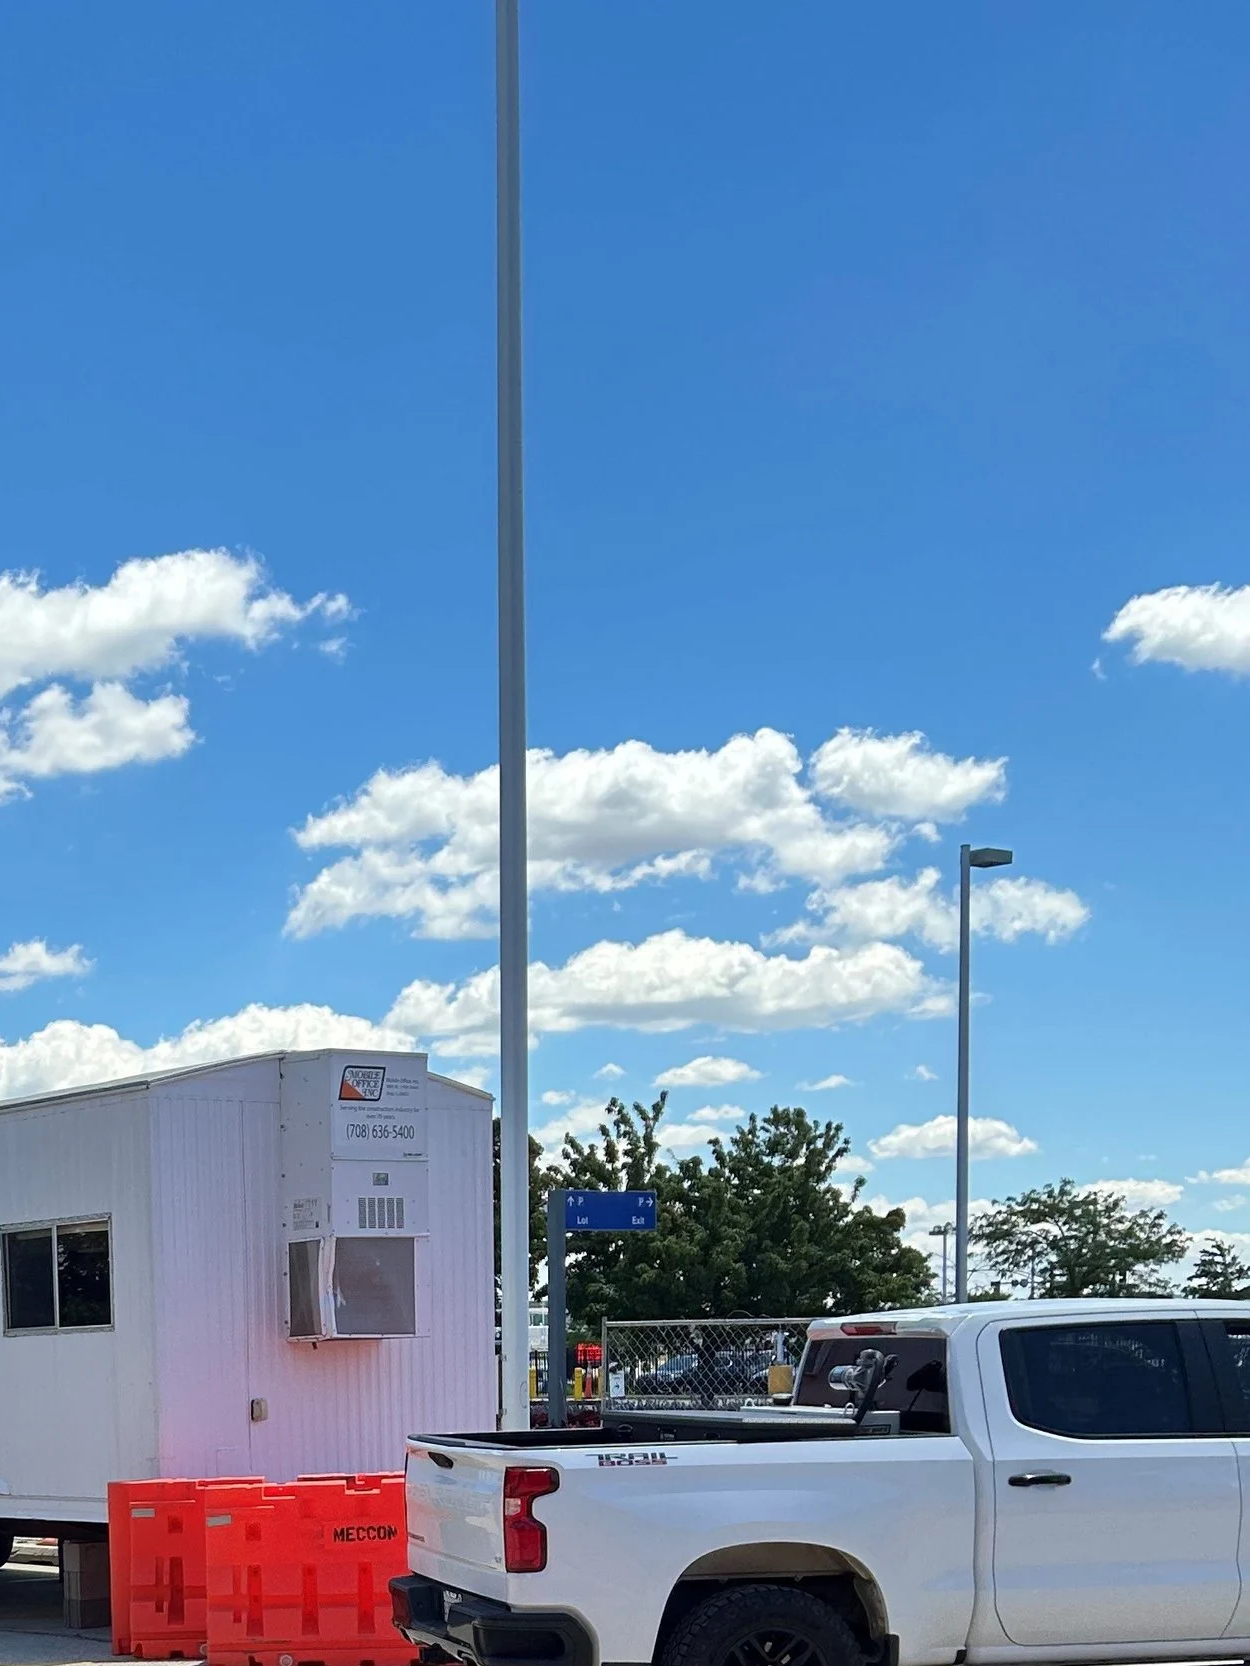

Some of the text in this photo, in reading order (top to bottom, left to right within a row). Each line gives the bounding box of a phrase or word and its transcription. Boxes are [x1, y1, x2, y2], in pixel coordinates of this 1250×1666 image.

[345, 1070, 381, 1080] MOBILE
[351, 1080, 380, 1089] OFFICE
[362, 1089, 379, 1097] INC
[346, 1124, 415, 1140] (708) 636-5400
[578, 1197, 584, 1206] P
[639, 1197, 645, 1207] P
[577, 1216, 589, 1225] Lot
[632, 1216, 645, 1225] Exit
[333, 1525, 397, 1542] MECCON
